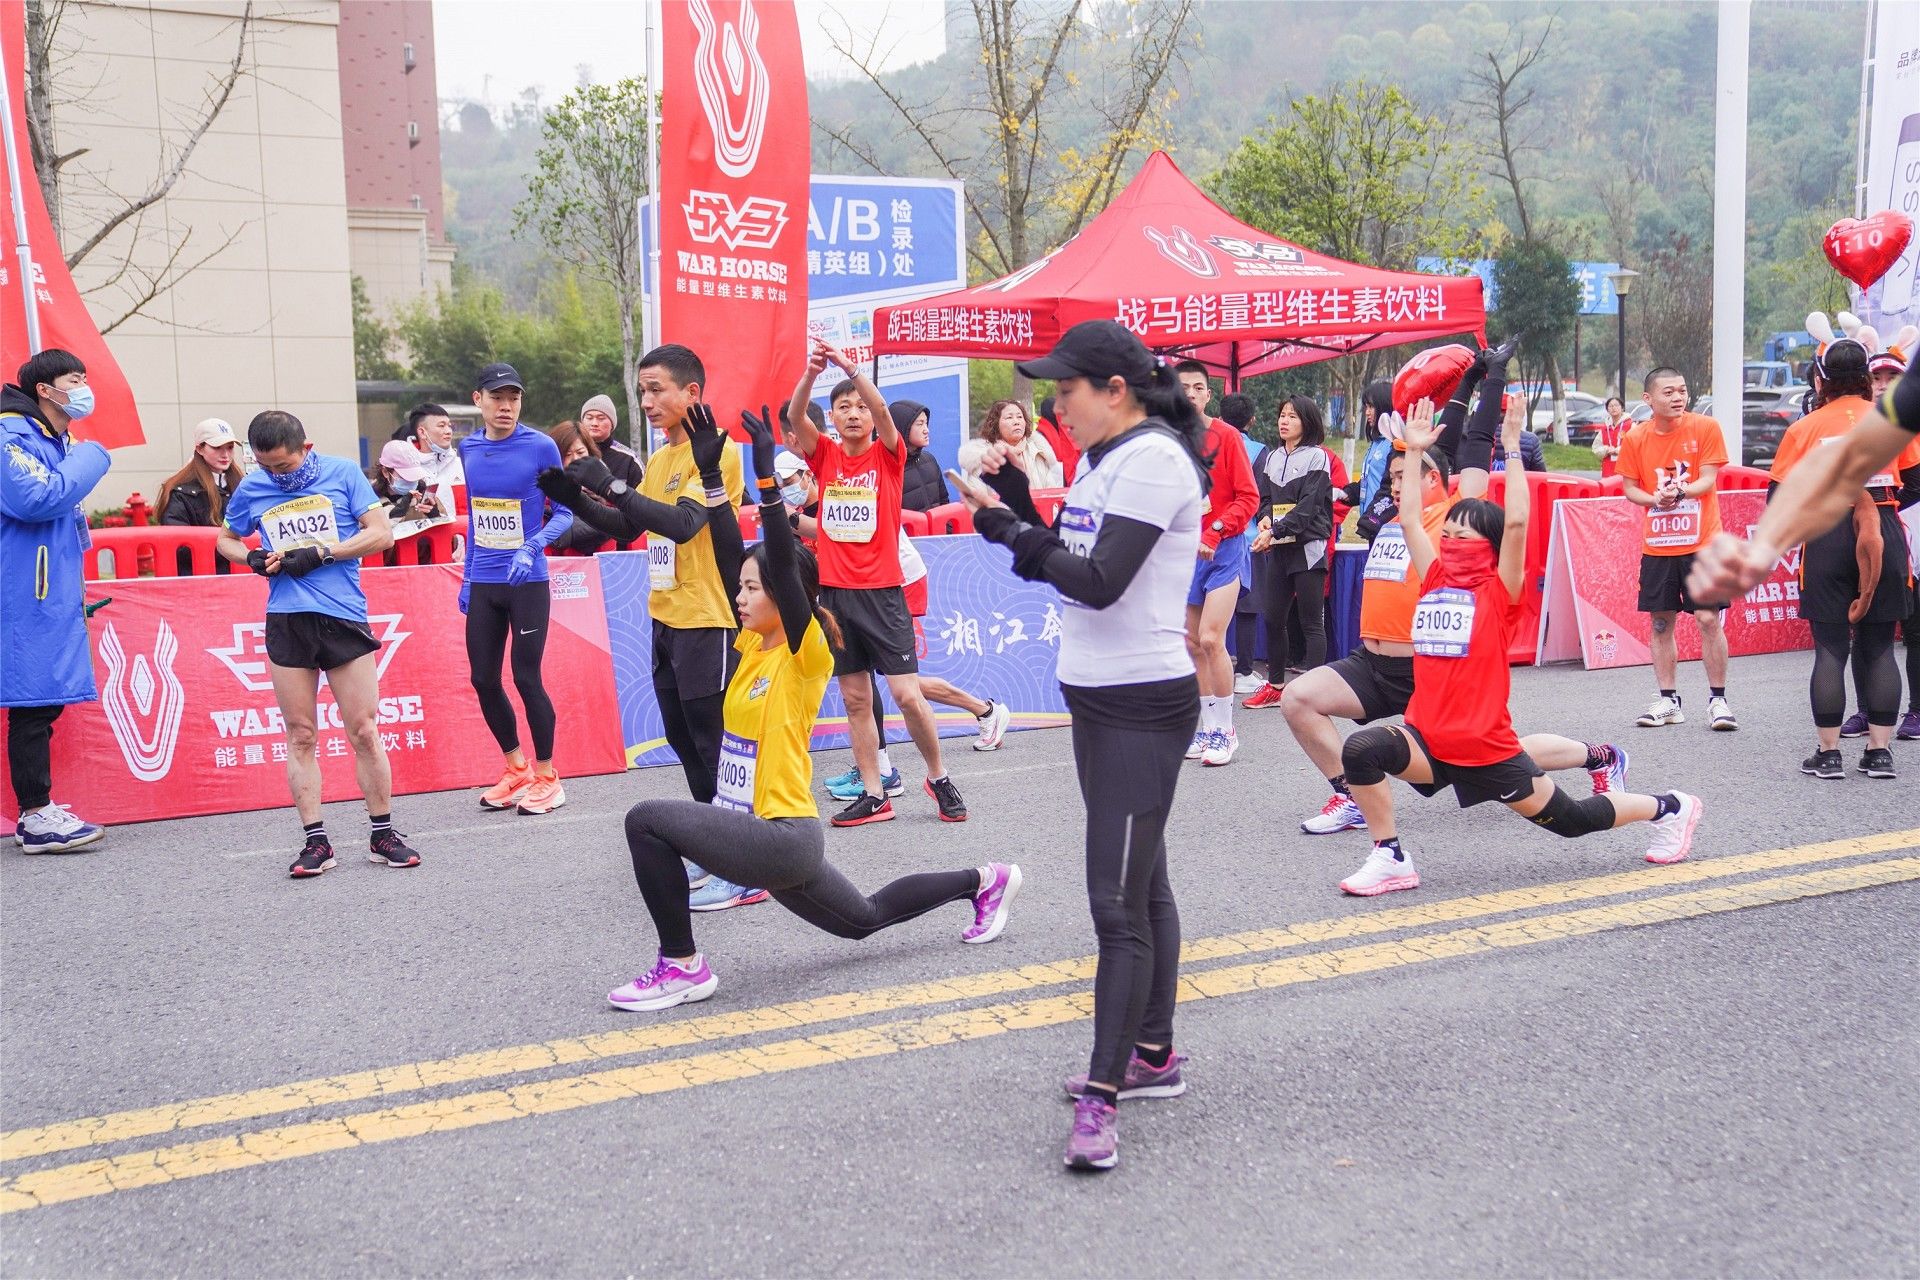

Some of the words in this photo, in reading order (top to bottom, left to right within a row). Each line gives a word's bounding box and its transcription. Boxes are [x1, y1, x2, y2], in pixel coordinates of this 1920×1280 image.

[1831, 229, 1883, 257] 1:10
[677, 250, 717, 277] WAR
[719, 256, 788, 286] HORSE
[676, 276, 788, 305] 能量型维生素饮料
[1114, 284, 1447, 335] 战马能量型维生素饮料
[887, 306, 1034, 347] 战马能量型维生素饮料
[278, 514, 329, 540] A1032
[477, 514, 516, 530] A1005
[827, 505, 870, 522] A1029
[1651, 515, 1691, 533] 01:00
[648, 545, 669, 566] 1008
[1372, 542, 1406, 560] C1422
[1416, 610, 1463, 631] B1003
[210, 706, 287, 739] WAR
[214, 728, 428, 769] 能量型生饮料
[718, 758, 746, 789] 1009
